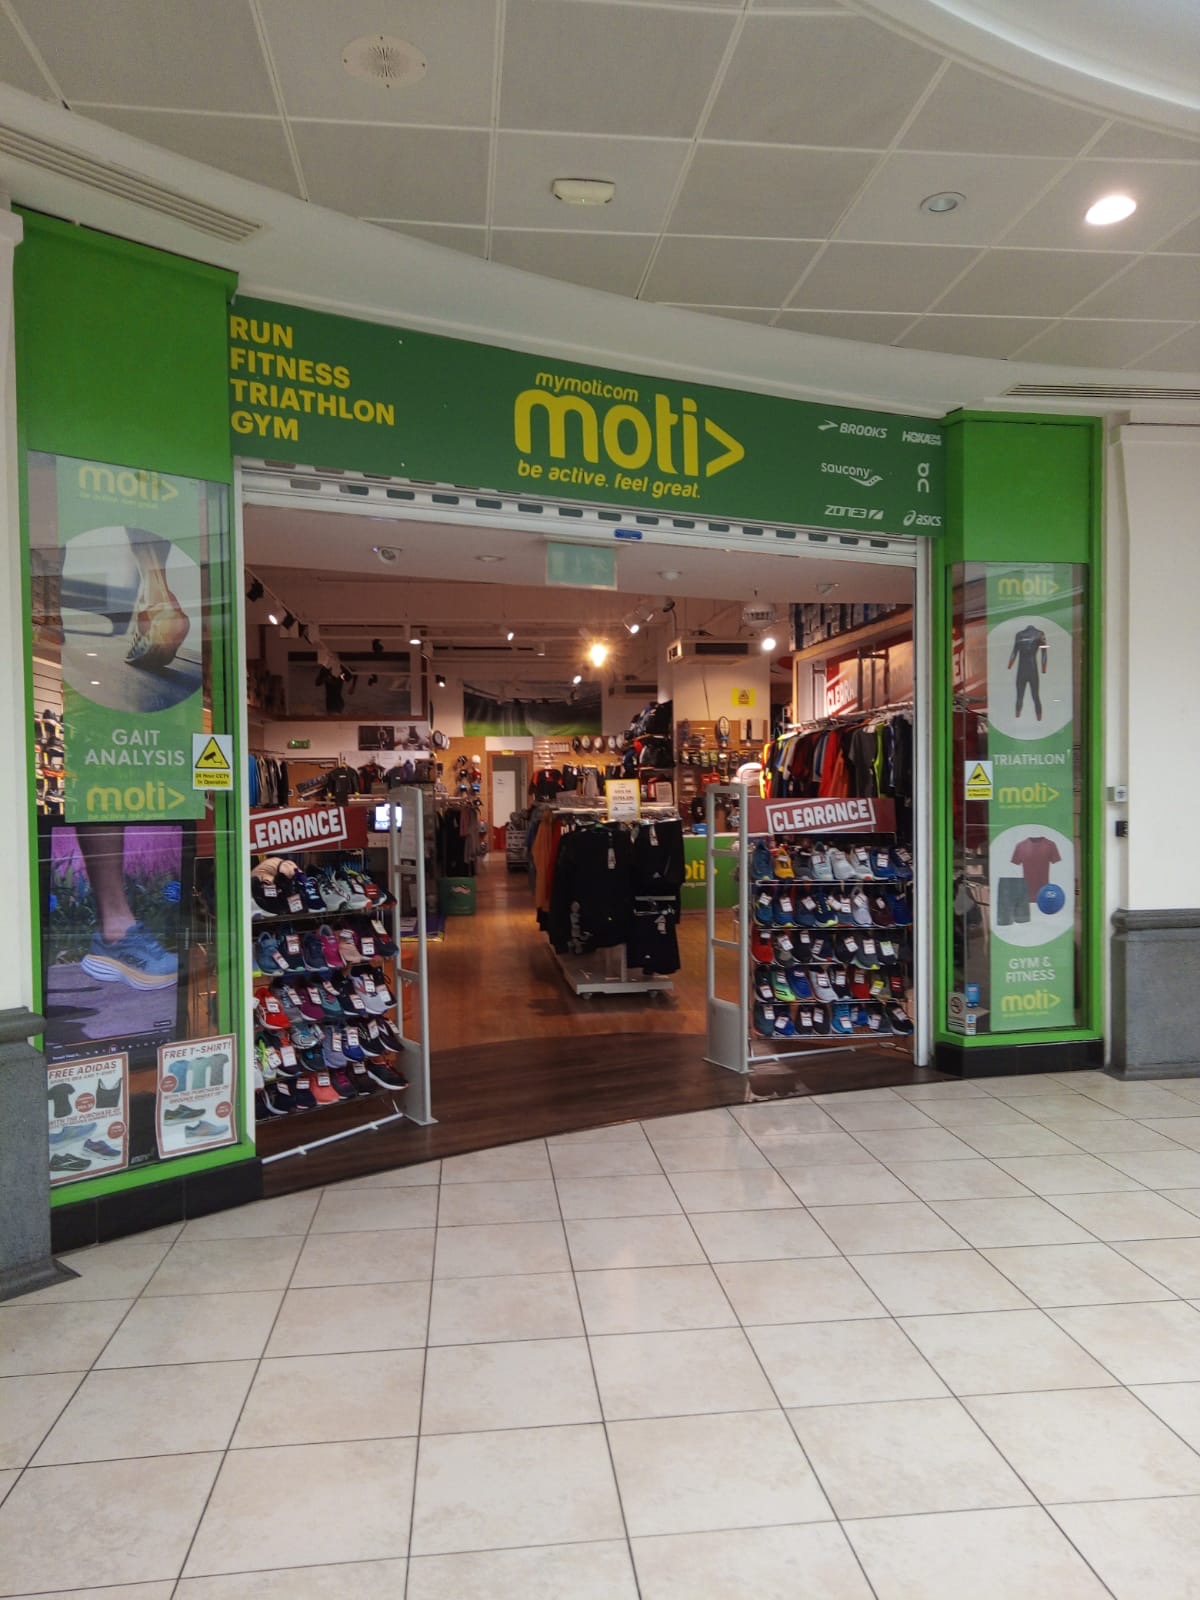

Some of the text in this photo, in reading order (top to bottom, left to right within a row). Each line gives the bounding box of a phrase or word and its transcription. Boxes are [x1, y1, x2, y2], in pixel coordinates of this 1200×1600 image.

[230, 315, 293, 348] RUN
[230, 347, 350, 388] FITNESS
[535, 372, 639, 402] mymoti.com
[230, 378, 395, 425] TRIATHLON
[231, 410, 298, 440] GYM
[840, 422, 888, 438] BROOKS
[517, 459, 700, 498] be active. feel great.
[821, 462, 870, 479] saucony
[112, 729, 160, 746] GAIT
[85, 749, 185, 766] ANALYSIS
[993, 753, 1065, 766] TRIATHLON
[772, 801, 869, 832] CLEARANCE
[250, 809, 341, 850] EARANCE
[1009, 957, 1039, 970] GYM
[1006, 969, 1055, 983] FITNESS
[164, 1041, 231, 1059] FREE T-SHIRT!
[49, 1060, 117, 1079] FREE ADIDAS
